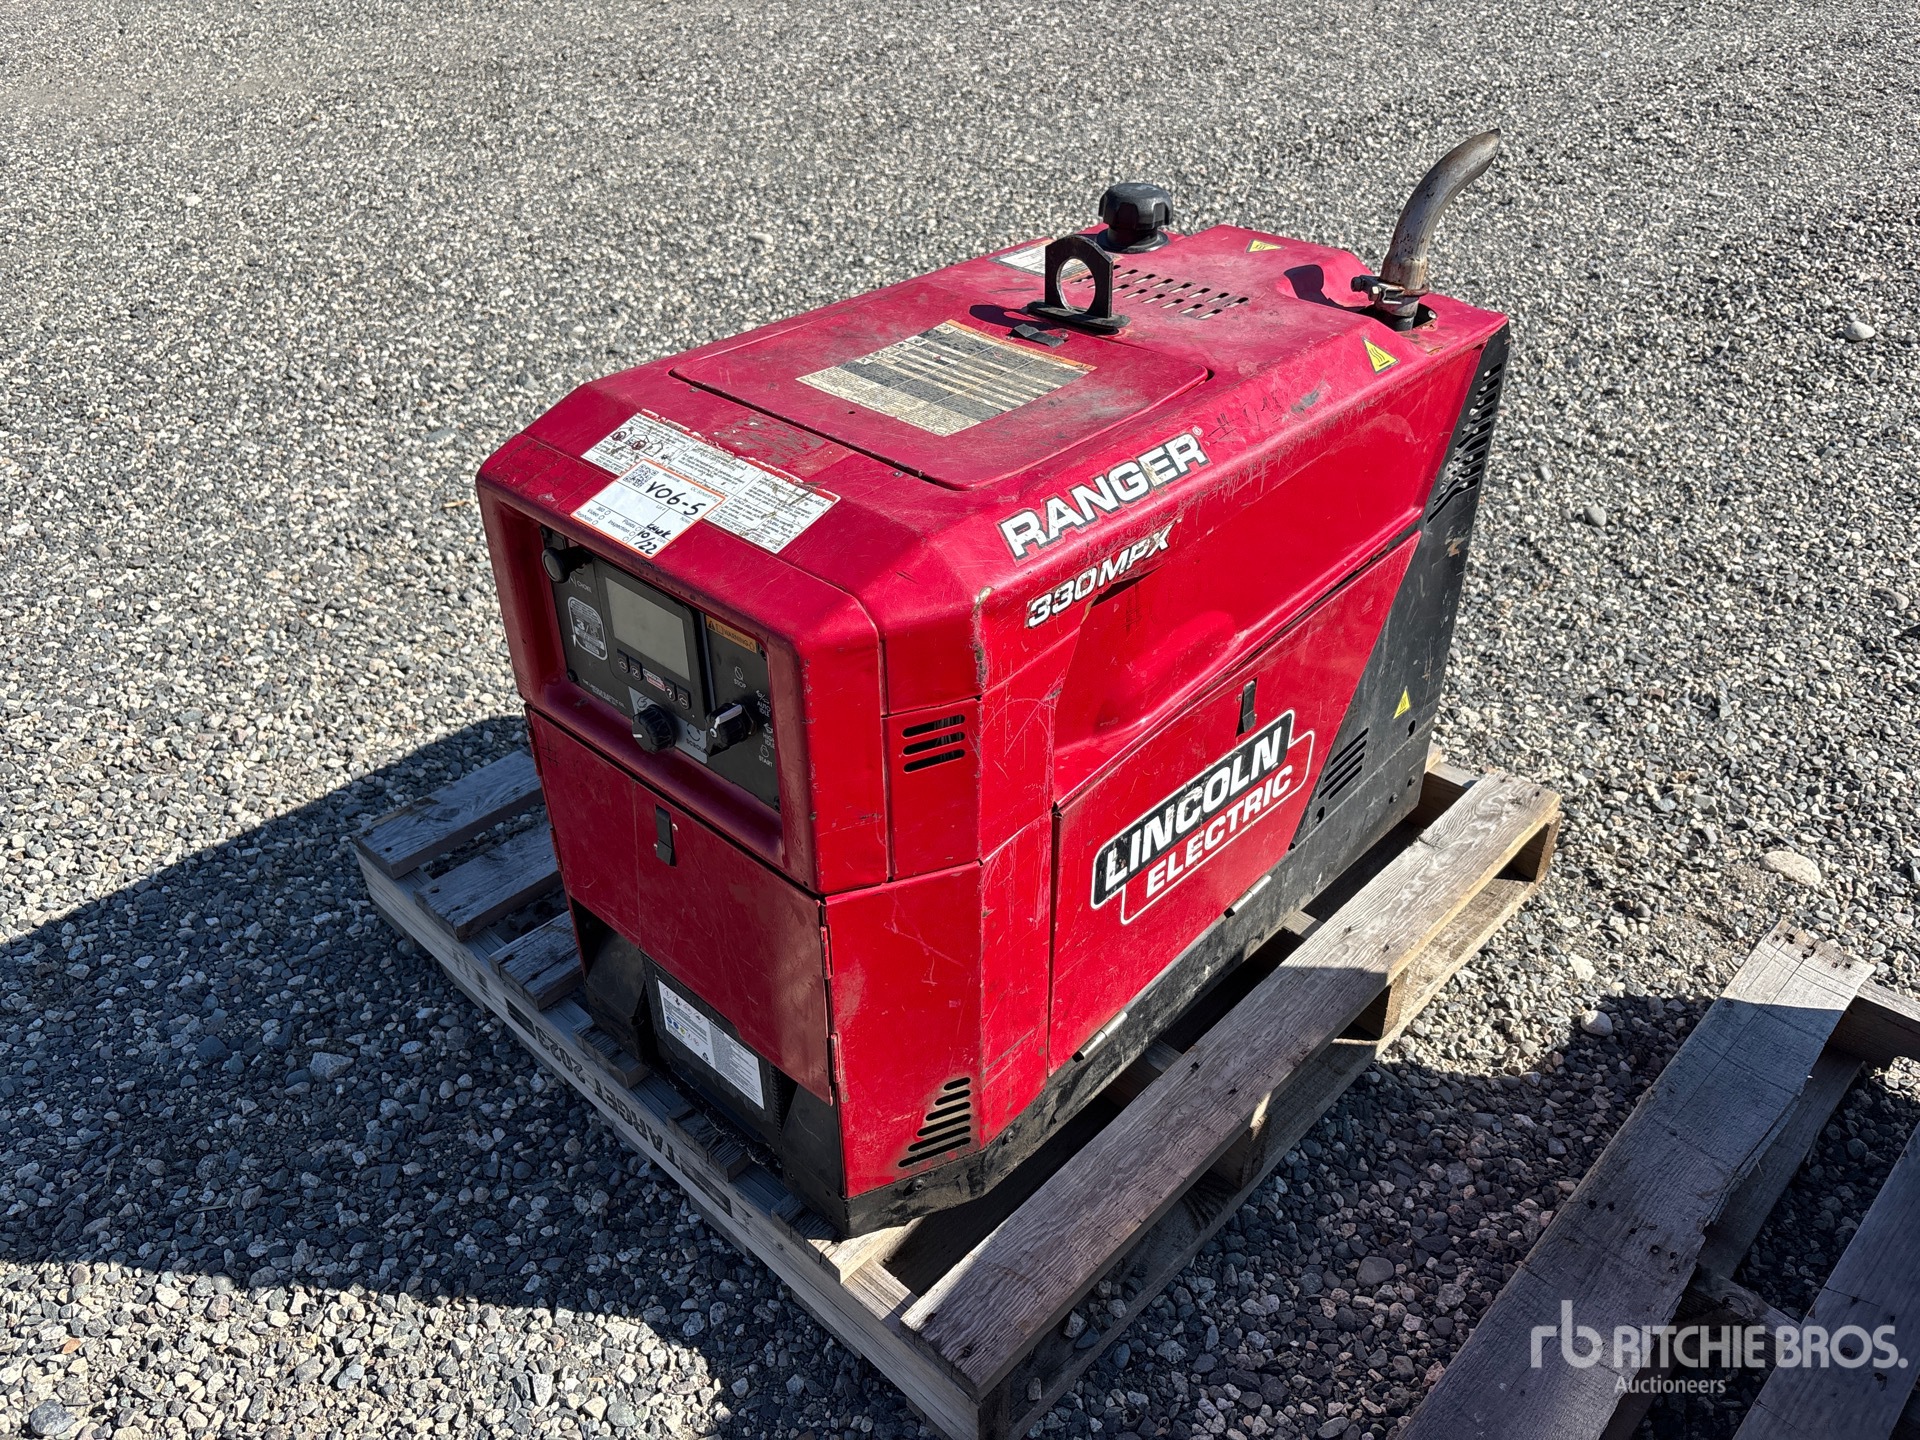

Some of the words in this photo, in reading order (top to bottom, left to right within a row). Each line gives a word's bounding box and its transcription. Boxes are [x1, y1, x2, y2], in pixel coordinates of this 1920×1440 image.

[608, 520, 630, 533] Inspection
[645, 481, 706, 515] V06-5
[1025, 524, 1175, 628] 330MPX
[734, 678, 746, 688] STOP
[758, 756, 773, 768] START
[1104, 726, 1282, 891] LINCOLN
[1146, 764, 1293, 898] ELECTRIC
[594, 1080, 680, 1169] TARGET
